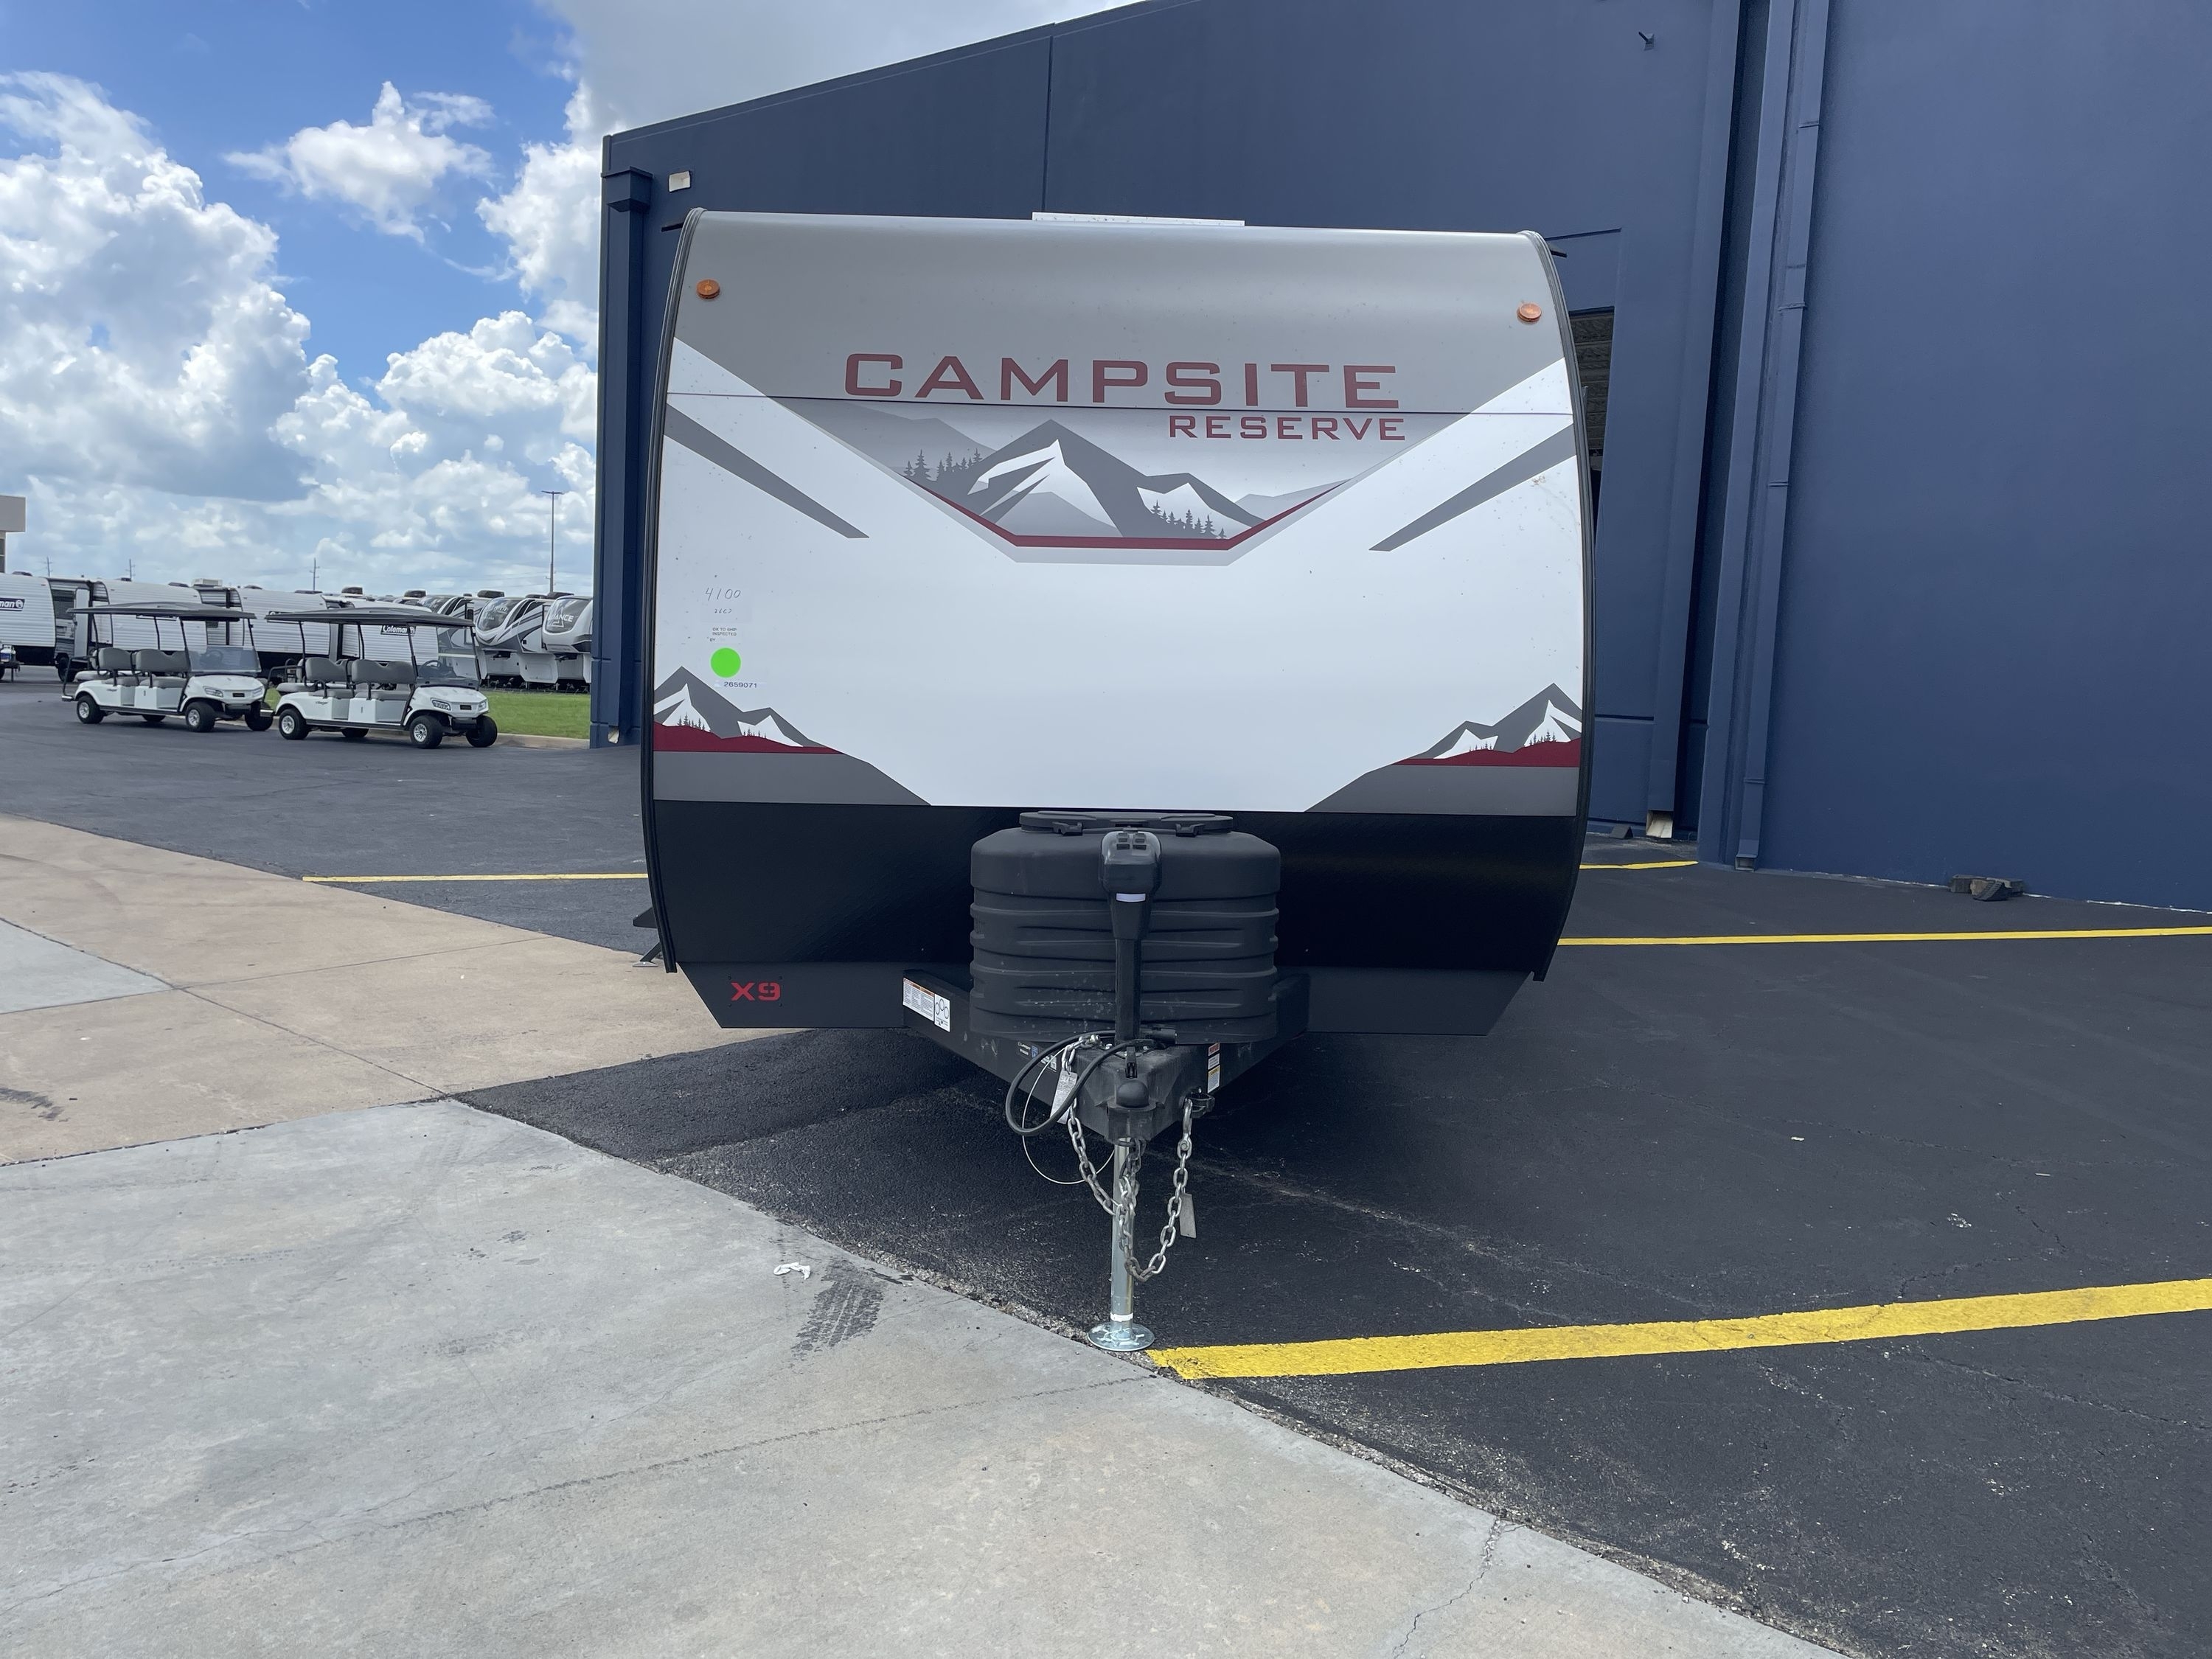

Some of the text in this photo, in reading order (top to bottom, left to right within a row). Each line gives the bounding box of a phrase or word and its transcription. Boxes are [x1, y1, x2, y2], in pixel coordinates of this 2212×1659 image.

[844, 352, 1400, 409] CAMPSITE
[1169, 415, 1405, 441] RESERVE
[705, 587, 741, 602] 4100
[731, 982, 781, 1001] X9
